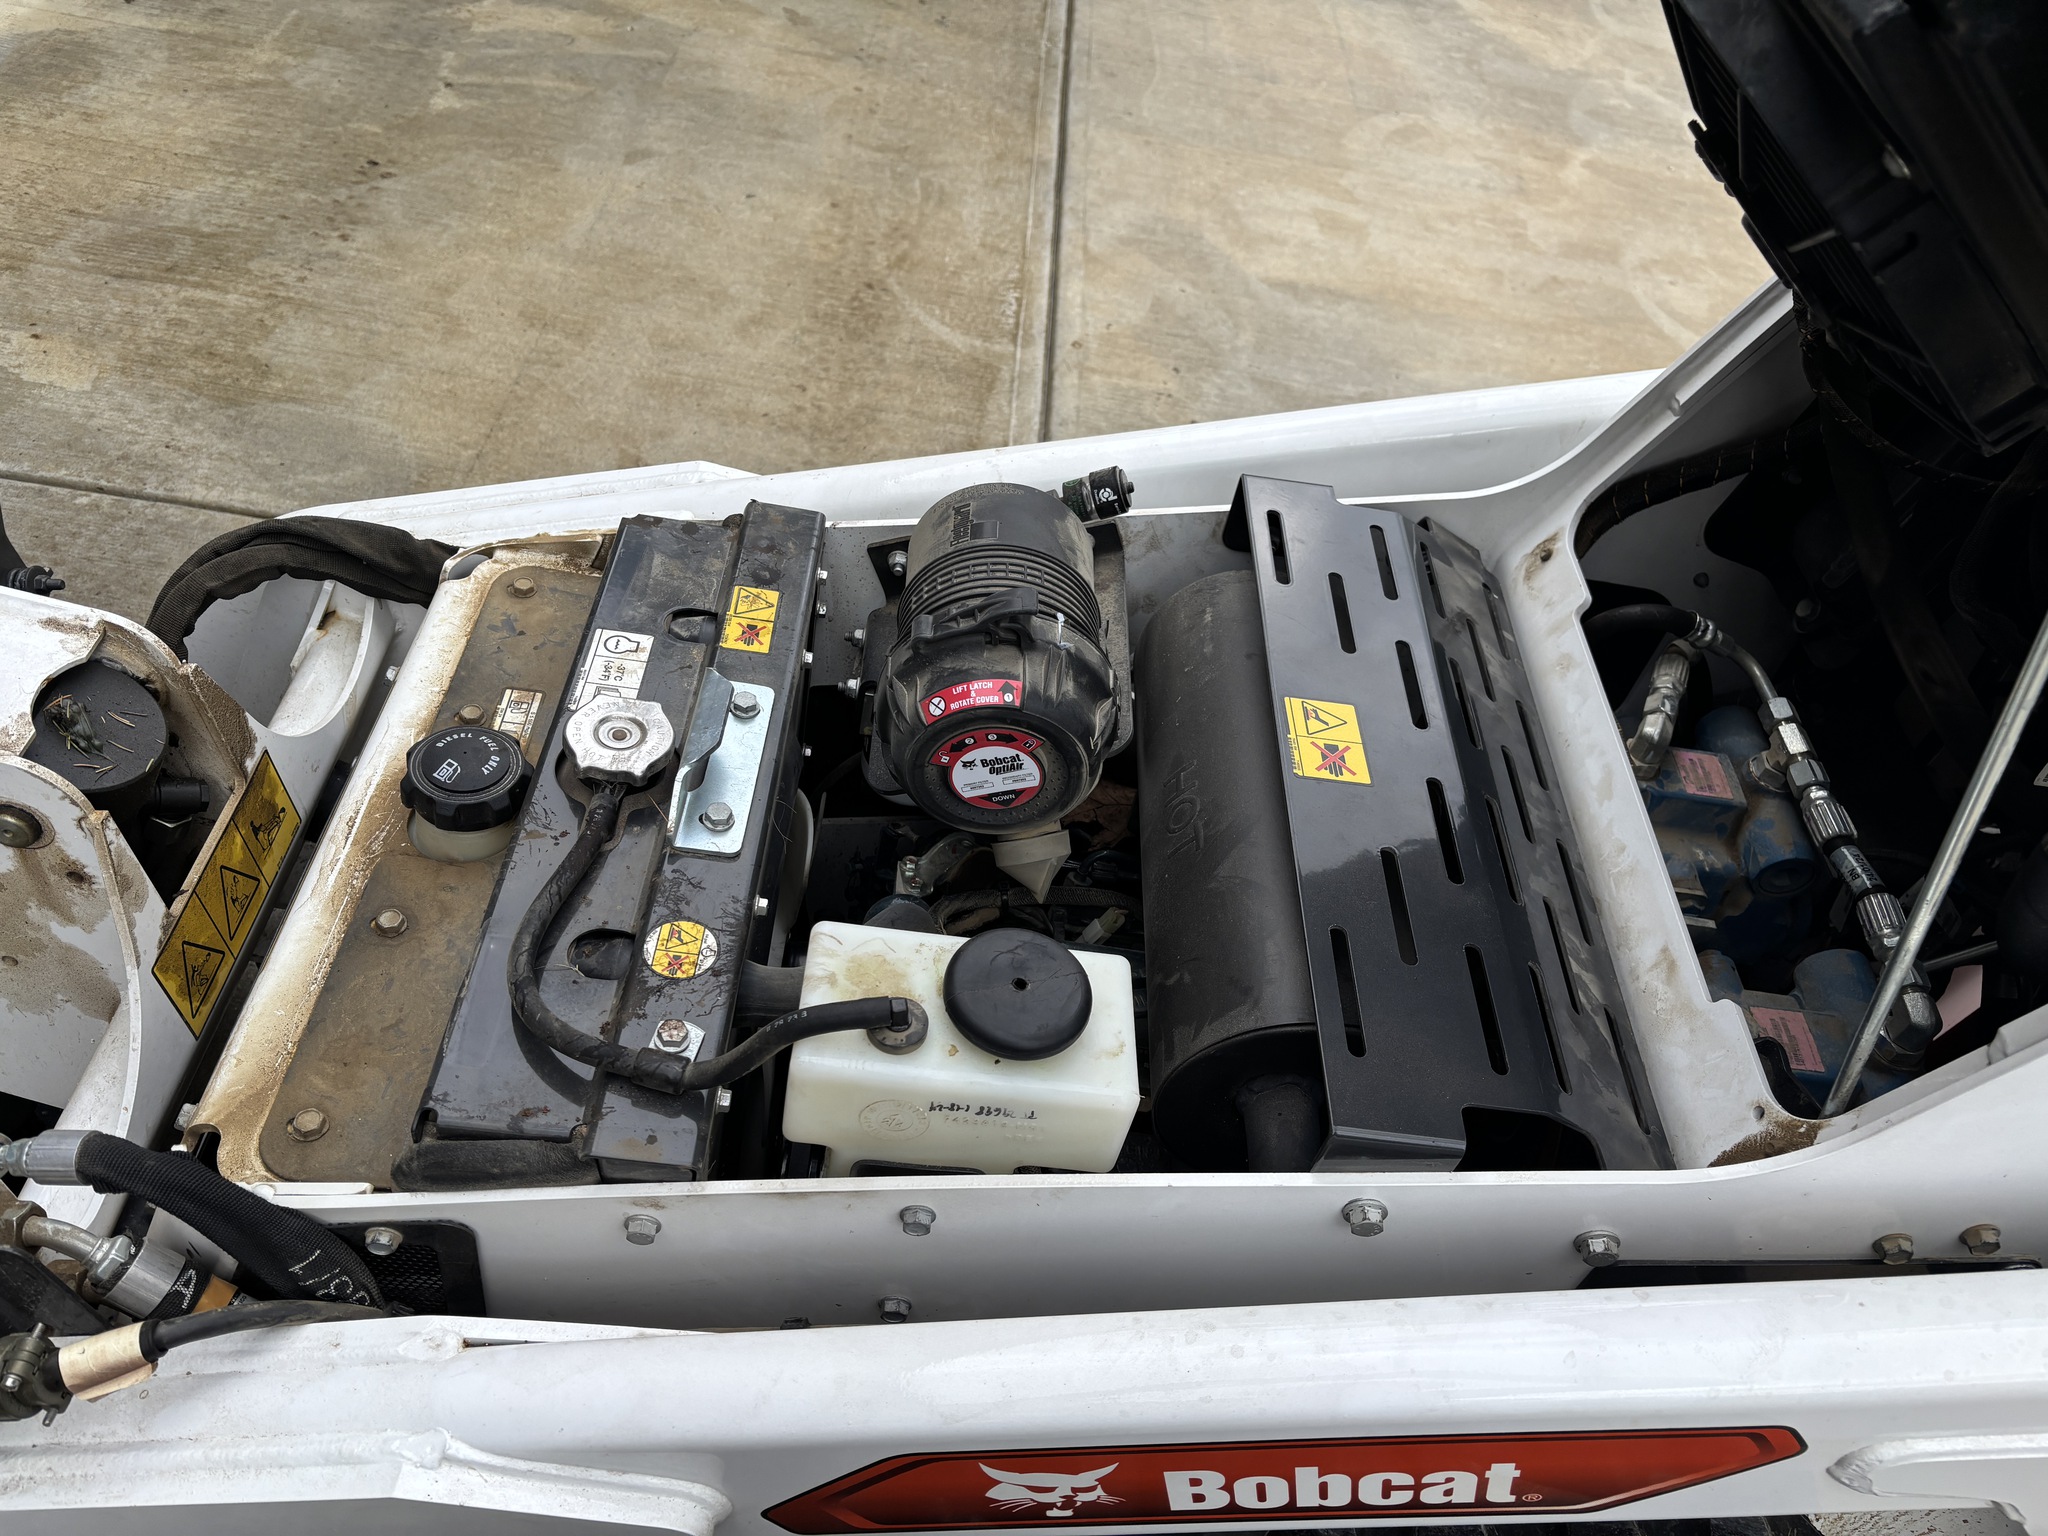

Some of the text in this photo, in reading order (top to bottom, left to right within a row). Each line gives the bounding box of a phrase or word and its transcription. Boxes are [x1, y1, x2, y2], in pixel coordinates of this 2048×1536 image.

[952, 682, 993, 694] LIFT LATCH
[950, 695, 999, 710] ROTATE COVER
[435, 732, 501, 775] DIESEL FUEL ONLY
[980, 753, 1022, 769] Bobcat
[988, 762, 1024, 776] OptiAir
[992, 793, 1016, 802] DOWN
[1163, 760, 1205, 860] HOT
[1163, 1462, 1521, 1511] Bobcat
